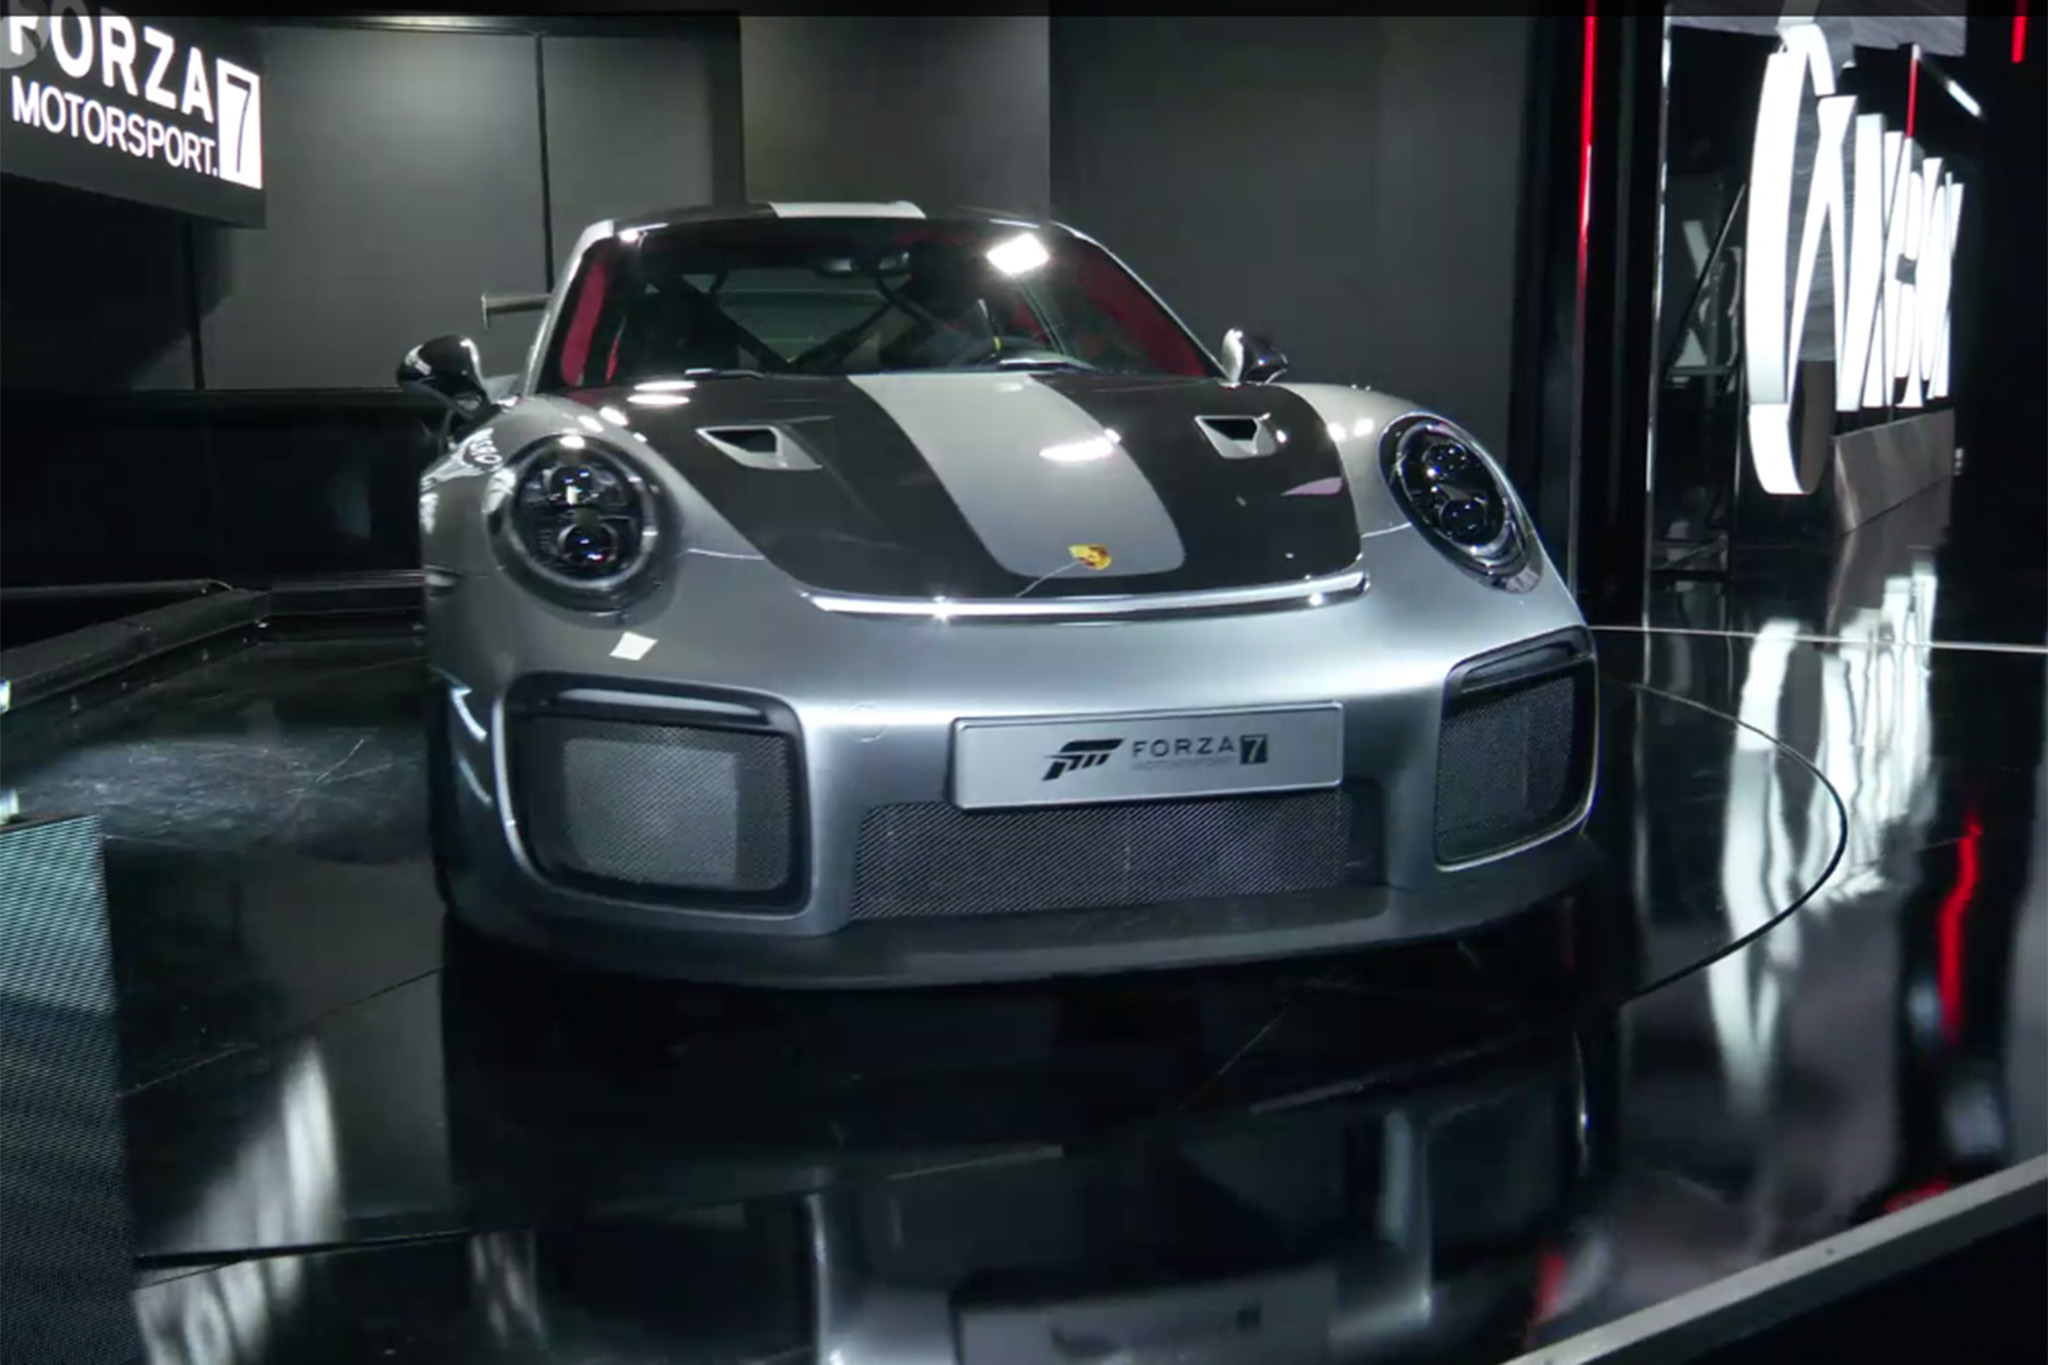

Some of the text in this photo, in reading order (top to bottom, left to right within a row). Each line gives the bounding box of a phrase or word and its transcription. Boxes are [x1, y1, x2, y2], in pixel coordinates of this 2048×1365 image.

[8, 0, 261, 186] FORZA 7
[1131, 735, 1236, 758] FORZA
[1240, 734, 1268, 764] 7
